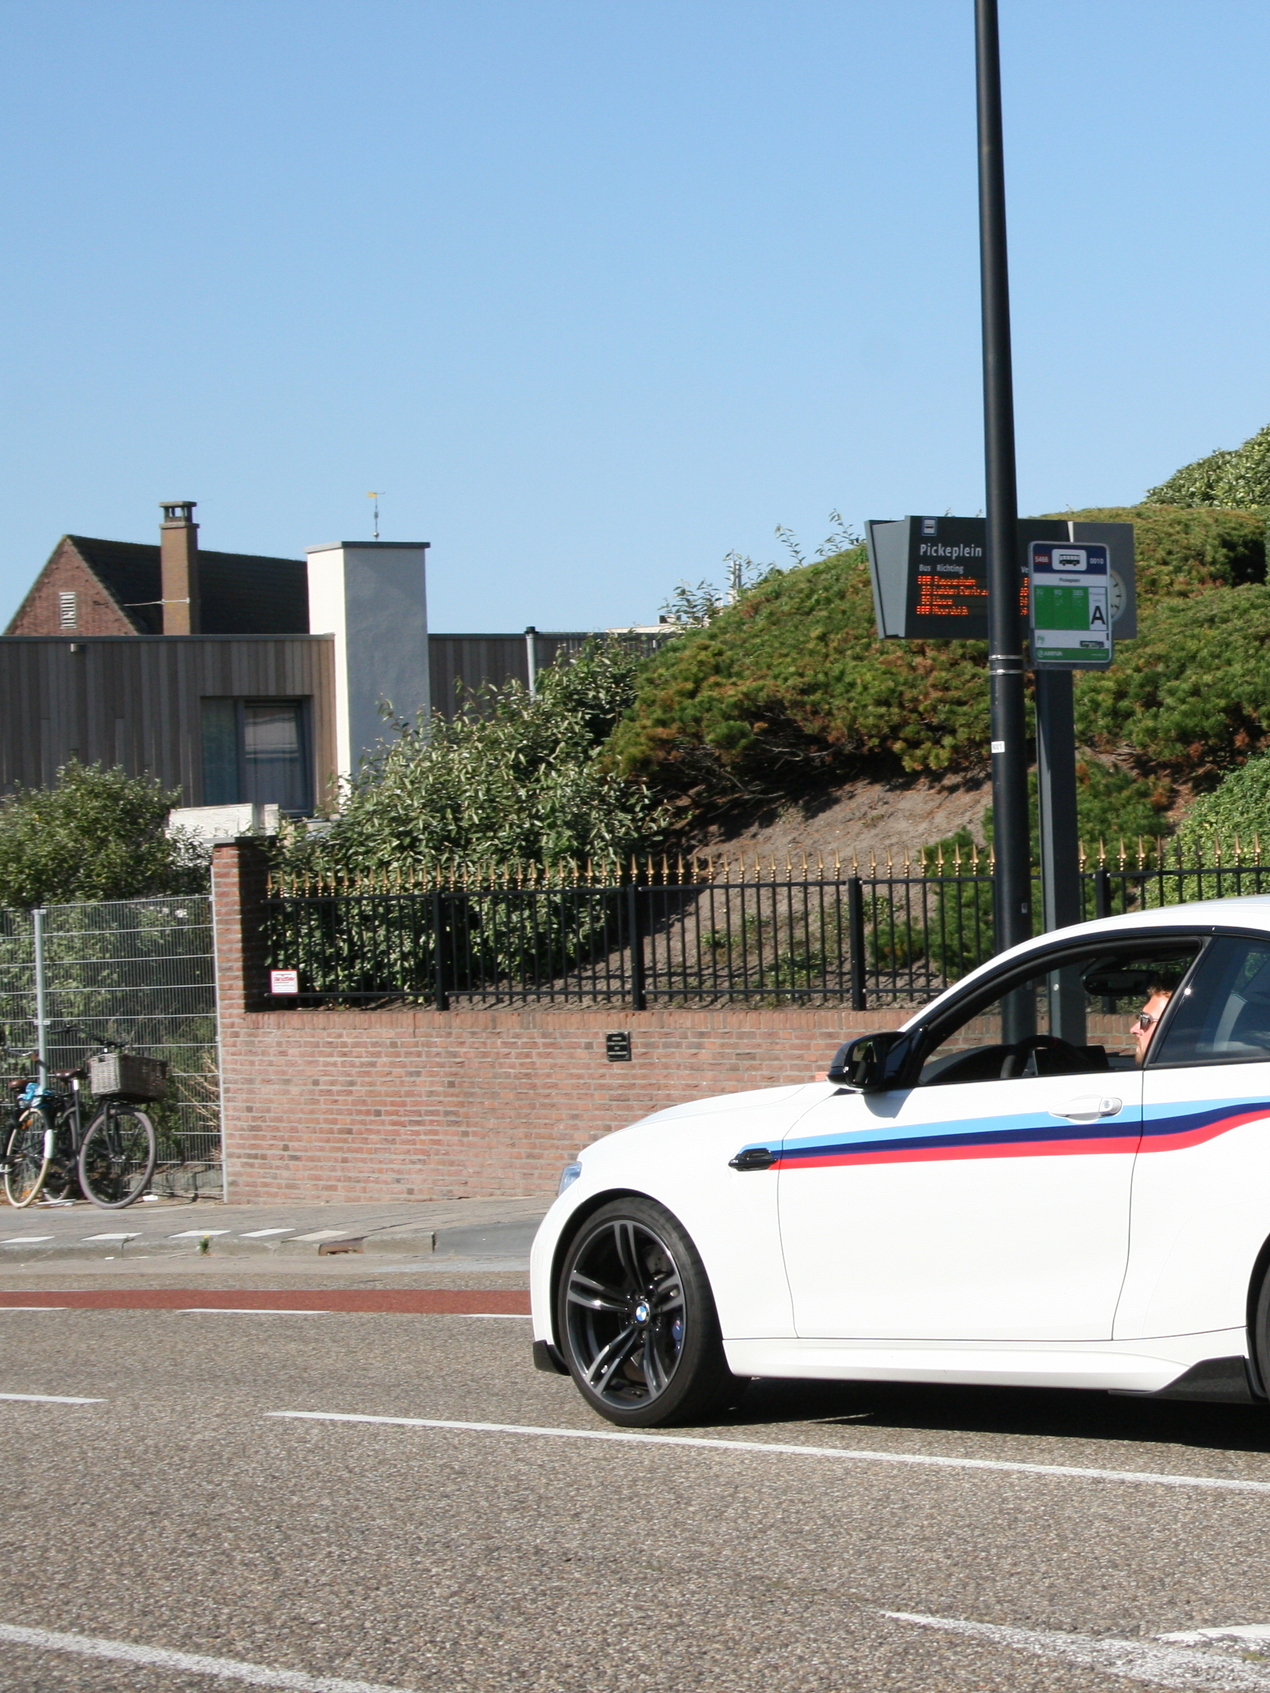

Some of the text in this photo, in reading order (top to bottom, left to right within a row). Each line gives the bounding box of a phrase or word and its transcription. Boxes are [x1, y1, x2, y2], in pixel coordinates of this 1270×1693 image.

[920, 543, 982, 559] Pickeplein
[919, 564, 931, 572] Bus
[936, 564, 964, 574] Richting
[1090, 606, 1106, 625] A
